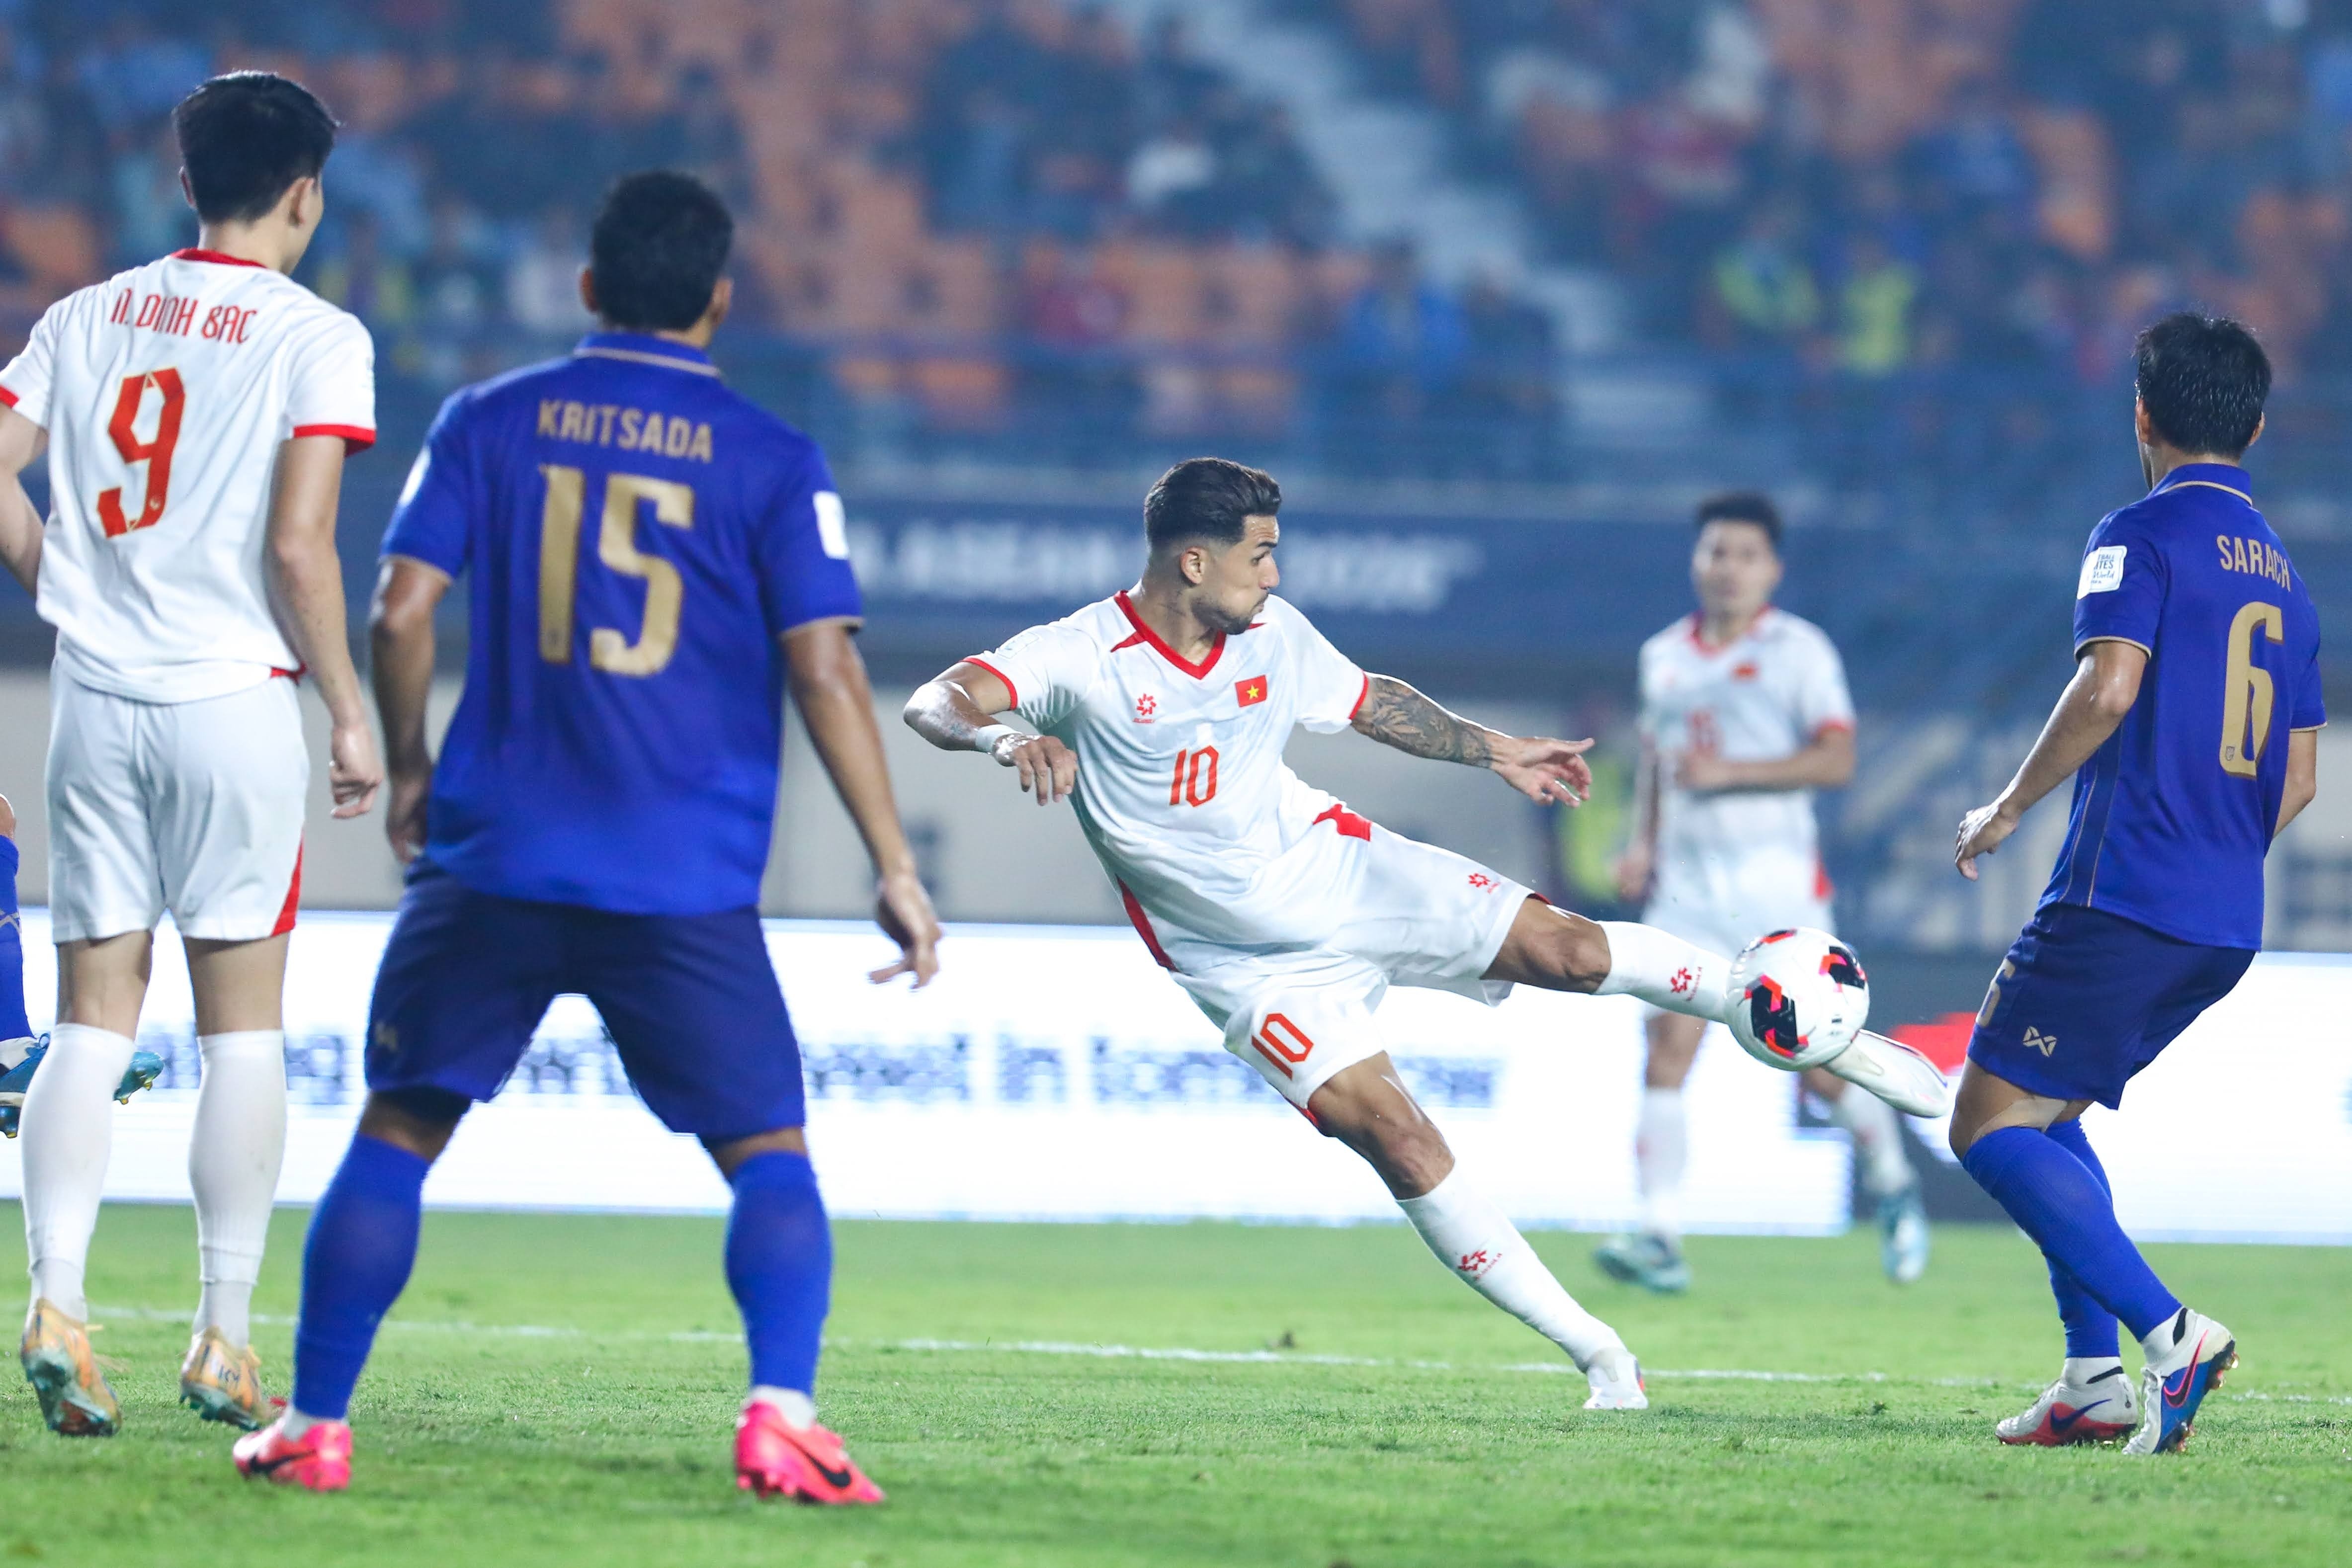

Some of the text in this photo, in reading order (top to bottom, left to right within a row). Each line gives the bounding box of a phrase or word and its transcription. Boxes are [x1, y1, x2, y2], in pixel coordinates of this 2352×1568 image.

[135, 294, 199, 337] DINH
[201, 304, 258, 344] BAC
[96, 367, 185, 539] 9
[537, 399, 713, 462] KRITSADA
[538, 463, 695, 678] 15
[2216, 534, 2291, 592] SARACH
[2218, 601, 2283, 780] 6
[1169, 745, 1219, 808] 10
[1251, 1012, 1315, 1082] 10
